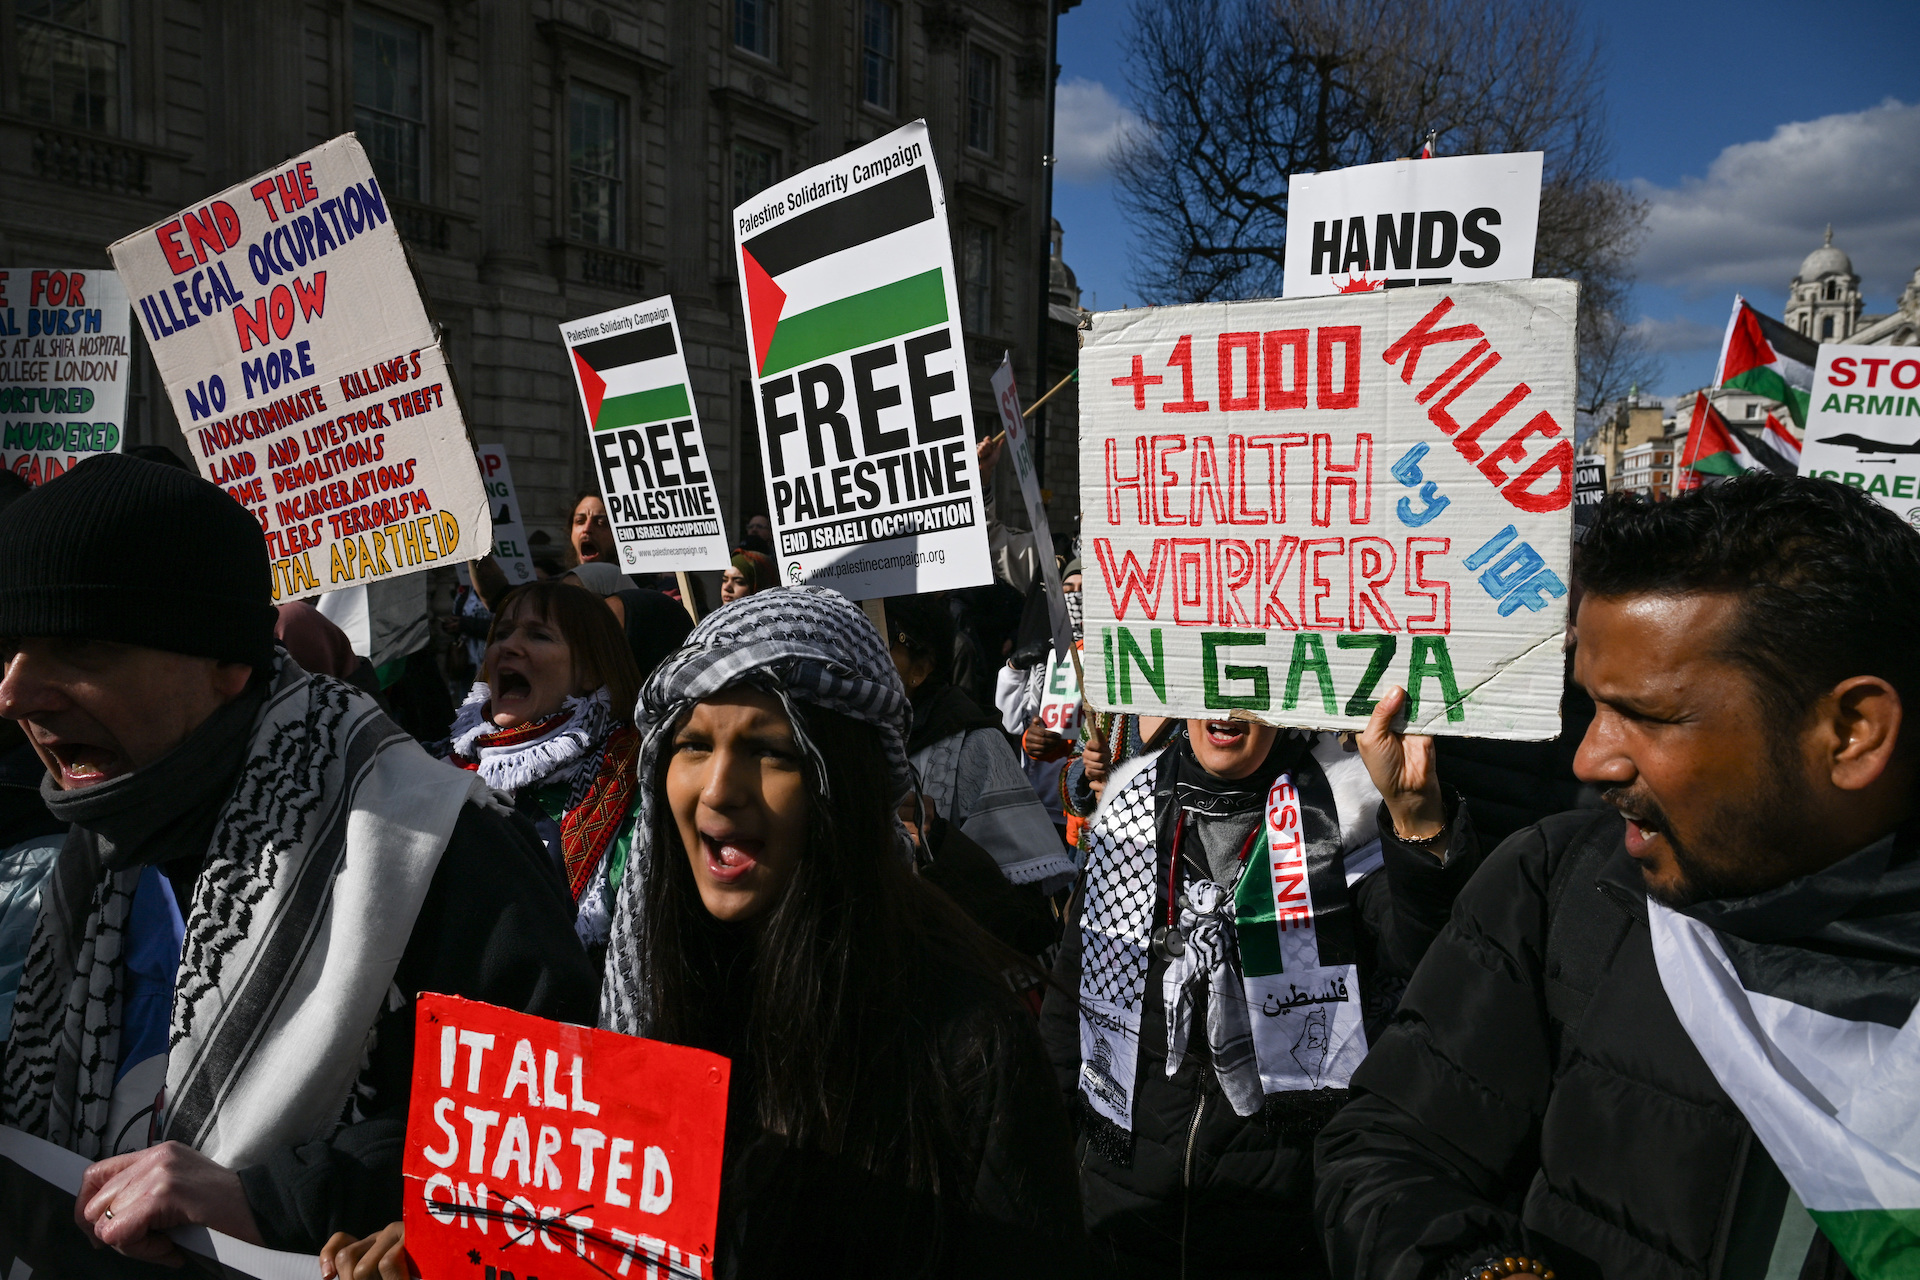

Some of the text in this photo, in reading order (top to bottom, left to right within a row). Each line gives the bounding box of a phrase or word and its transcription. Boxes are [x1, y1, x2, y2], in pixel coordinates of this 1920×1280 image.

[155, 161, 319, 276] END THE
[738, 142, 922, 236] Palestine Solidarity Campaign
[139, 177, 388, 341] ILLEGAL OCCUPATION
[1310, 206, 1502, 276] HANDS
[27, 308, 102, 338] BURSH
[30, 269, 86, 307] FOR
[232, 271, 327, 354] NOW
[566, 308, 670, 342] Palestine Solidarity Campaign
[12, 339, 31, 359] AT
[79, 336, 129, 359] HOSPITAL
[54, 359, 118, 382] LONDON
[184, 339, 316, 421] NO MORE
[1111, 325, 1362, 413] +1000
[3, 420, 120, 452] MURDERED
[198, 349, 422, 458] INDISCRIMINATE KILLINGS
[209, 383, 444, 486] LAND AND LIVESTOCK THEFT
[760, 328, 964, 477] FREE
[1383, 296, 1575, 514] KILLED
[272, 433, 385, 494] DEMOLITIONS
[275, 458, 417, 527] INCARCERATIONS
[594, 419, 708, 495] FREE
[772, 440, 971, 526] PALESTINE
[1104, 431, 1372, 528] HEALTH
[1390, 440, 1451, 528] by
[265, 488, 432, 560] TLERS TERRORISM
[608, 485, 716, 524] PALESTINE
[617, 520, 719, 541] END ISRAELI OCCUPATION
[781, 501, 973, 555] END ISRAELI OCCUPATION
[330, 509, 460, 584] APARTHEID
[811, 548, 946, 580] www.palestinecampaign.org
[1094, 534, 1451, 635] WORKERS
[1101, 626, 1465, 724] IN GAZA
[1268, 780, 1311, 932] ESTINE
[1262, 976, 1349, 1018] فلسطين
[440, 1025, 601, 1117] IT ALL
[423, 1096, 674, 1215] STARTED
[423, 1172, 489, 1235] ON
